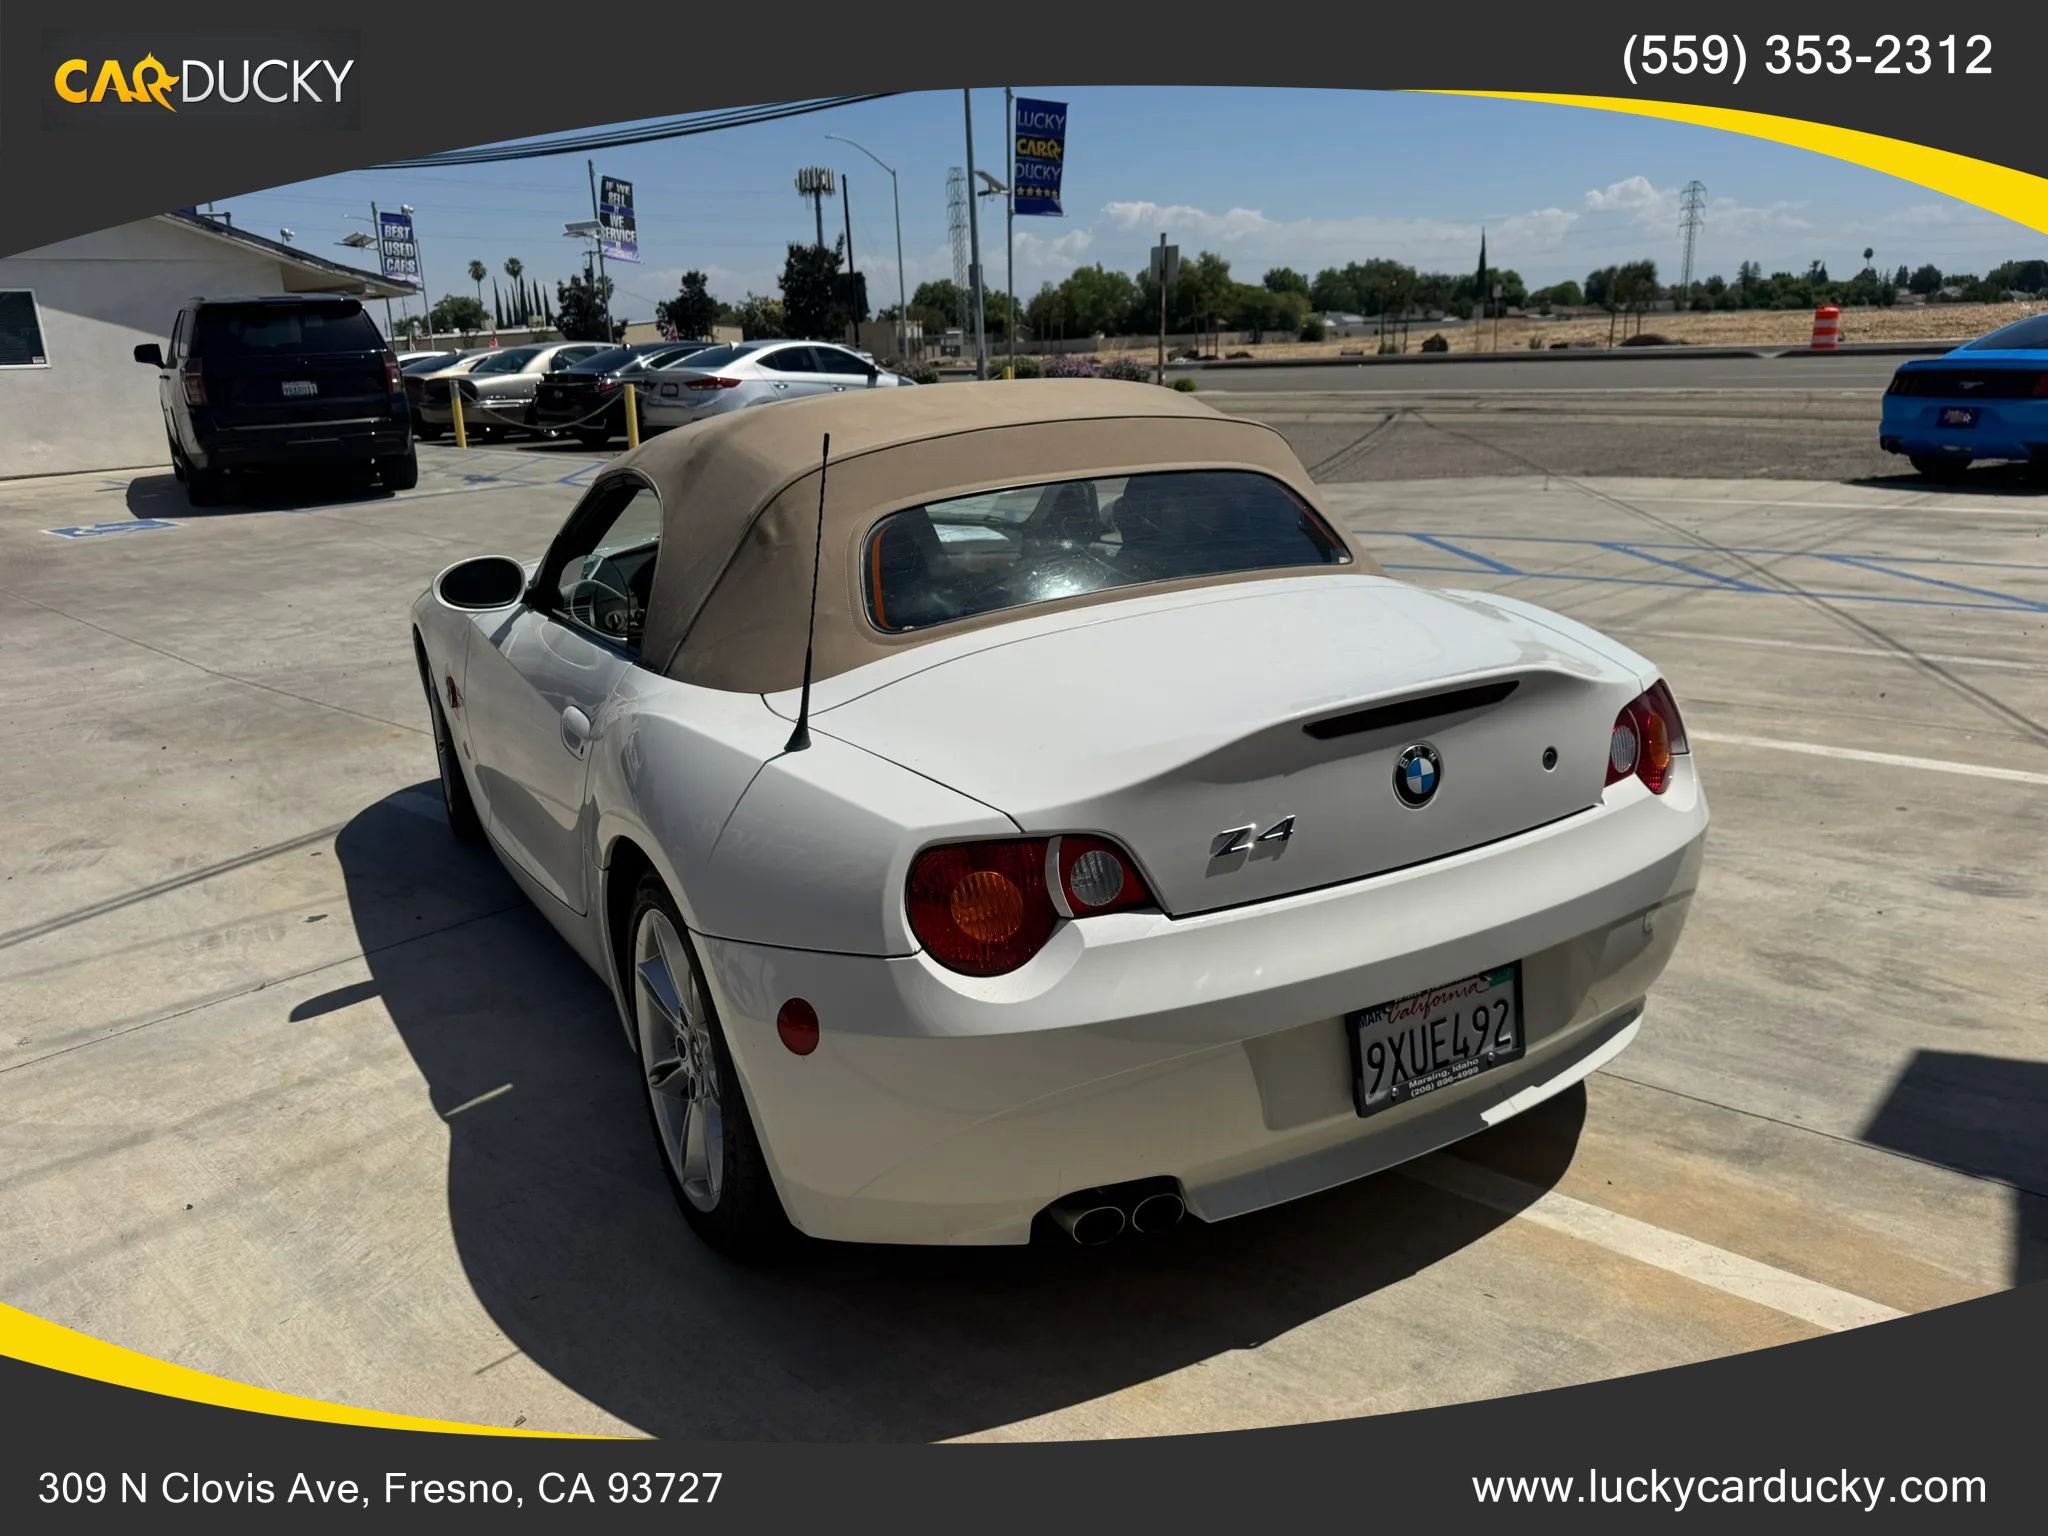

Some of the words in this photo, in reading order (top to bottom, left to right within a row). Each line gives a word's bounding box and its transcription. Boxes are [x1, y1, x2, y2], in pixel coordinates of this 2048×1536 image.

[1017, 109, 1065, 131] LUCKY
[1015, 162, 1062, 182] DUCKY
[616, 183, 631, 196] WE
[608, 191, 627, 208] SELL
[609, 213, 625, 227] WE
[384, 225, 411, 240] BEST
[384, 241, 415, 257] USED
[1210, 814, 1296, 858] Z4
[1359, 1009, 1383, 1029] MAR
[1387, 980, 1490, 1025] California
[1367, 999, 1512, 1097] 9XUE492
[1408, 1070, 1450, 1088] Marsing,
[1452, 1058, 1479, 1072] Idaho
[1410, 1083, 1435, 1097] (208)
